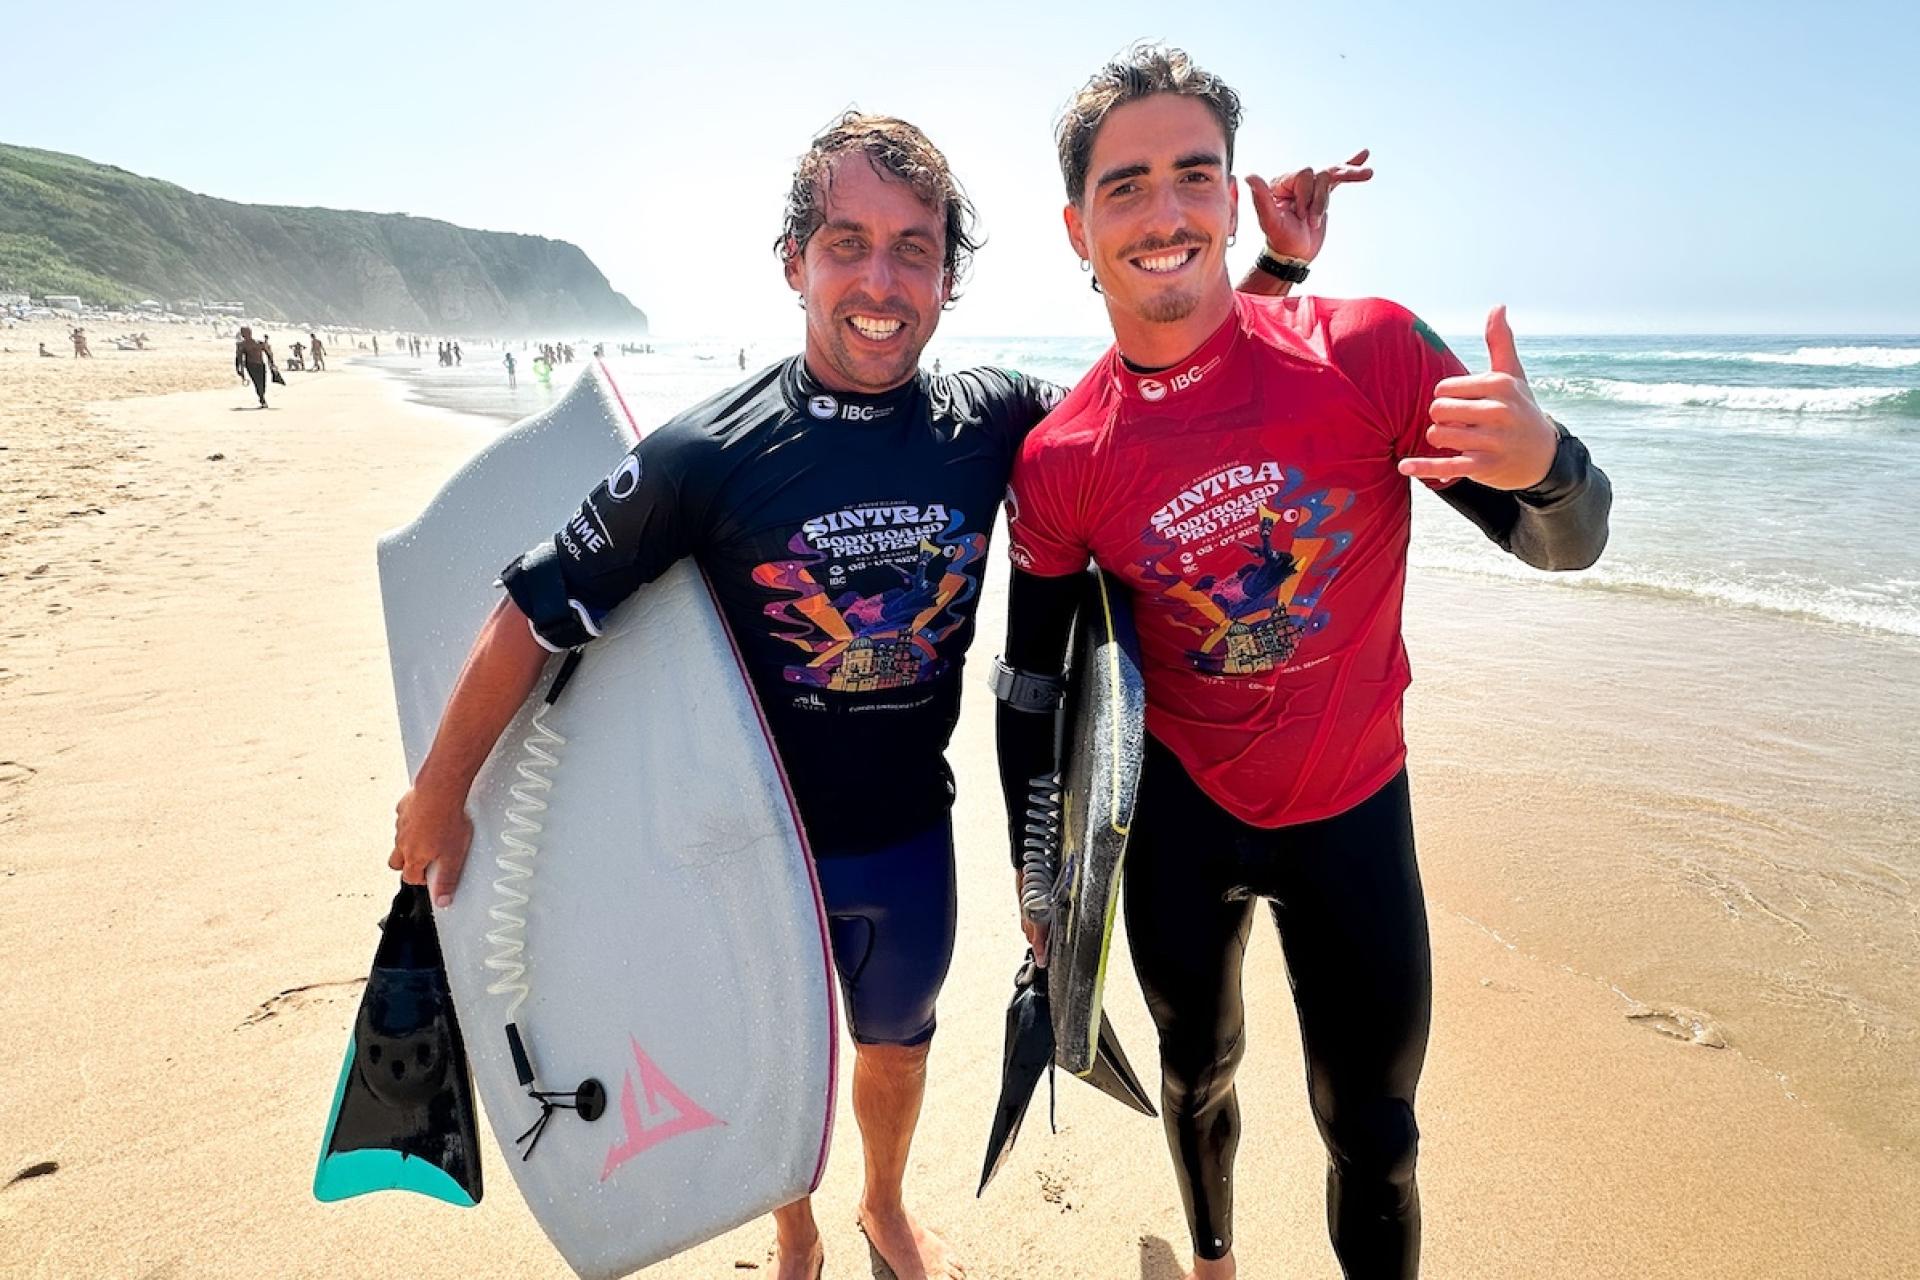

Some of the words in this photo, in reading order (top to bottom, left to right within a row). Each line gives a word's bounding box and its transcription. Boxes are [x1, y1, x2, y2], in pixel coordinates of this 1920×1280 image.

[1169, 365, 1204, 393] IBC
[841, 404, 874, 421] IBC
[1150, 461, 1285, 533] SINTRA
[1163, 482, 1279, 540] BODYBOARD
[802, 503, 950, 542] SINTRA
[815, 522, 945, 550] BODYBOARD
[1179, 521, 1218, 545] PRO
[1219, 500, 1268, 528] FEST
[831, 543, 875, 559] PRO
